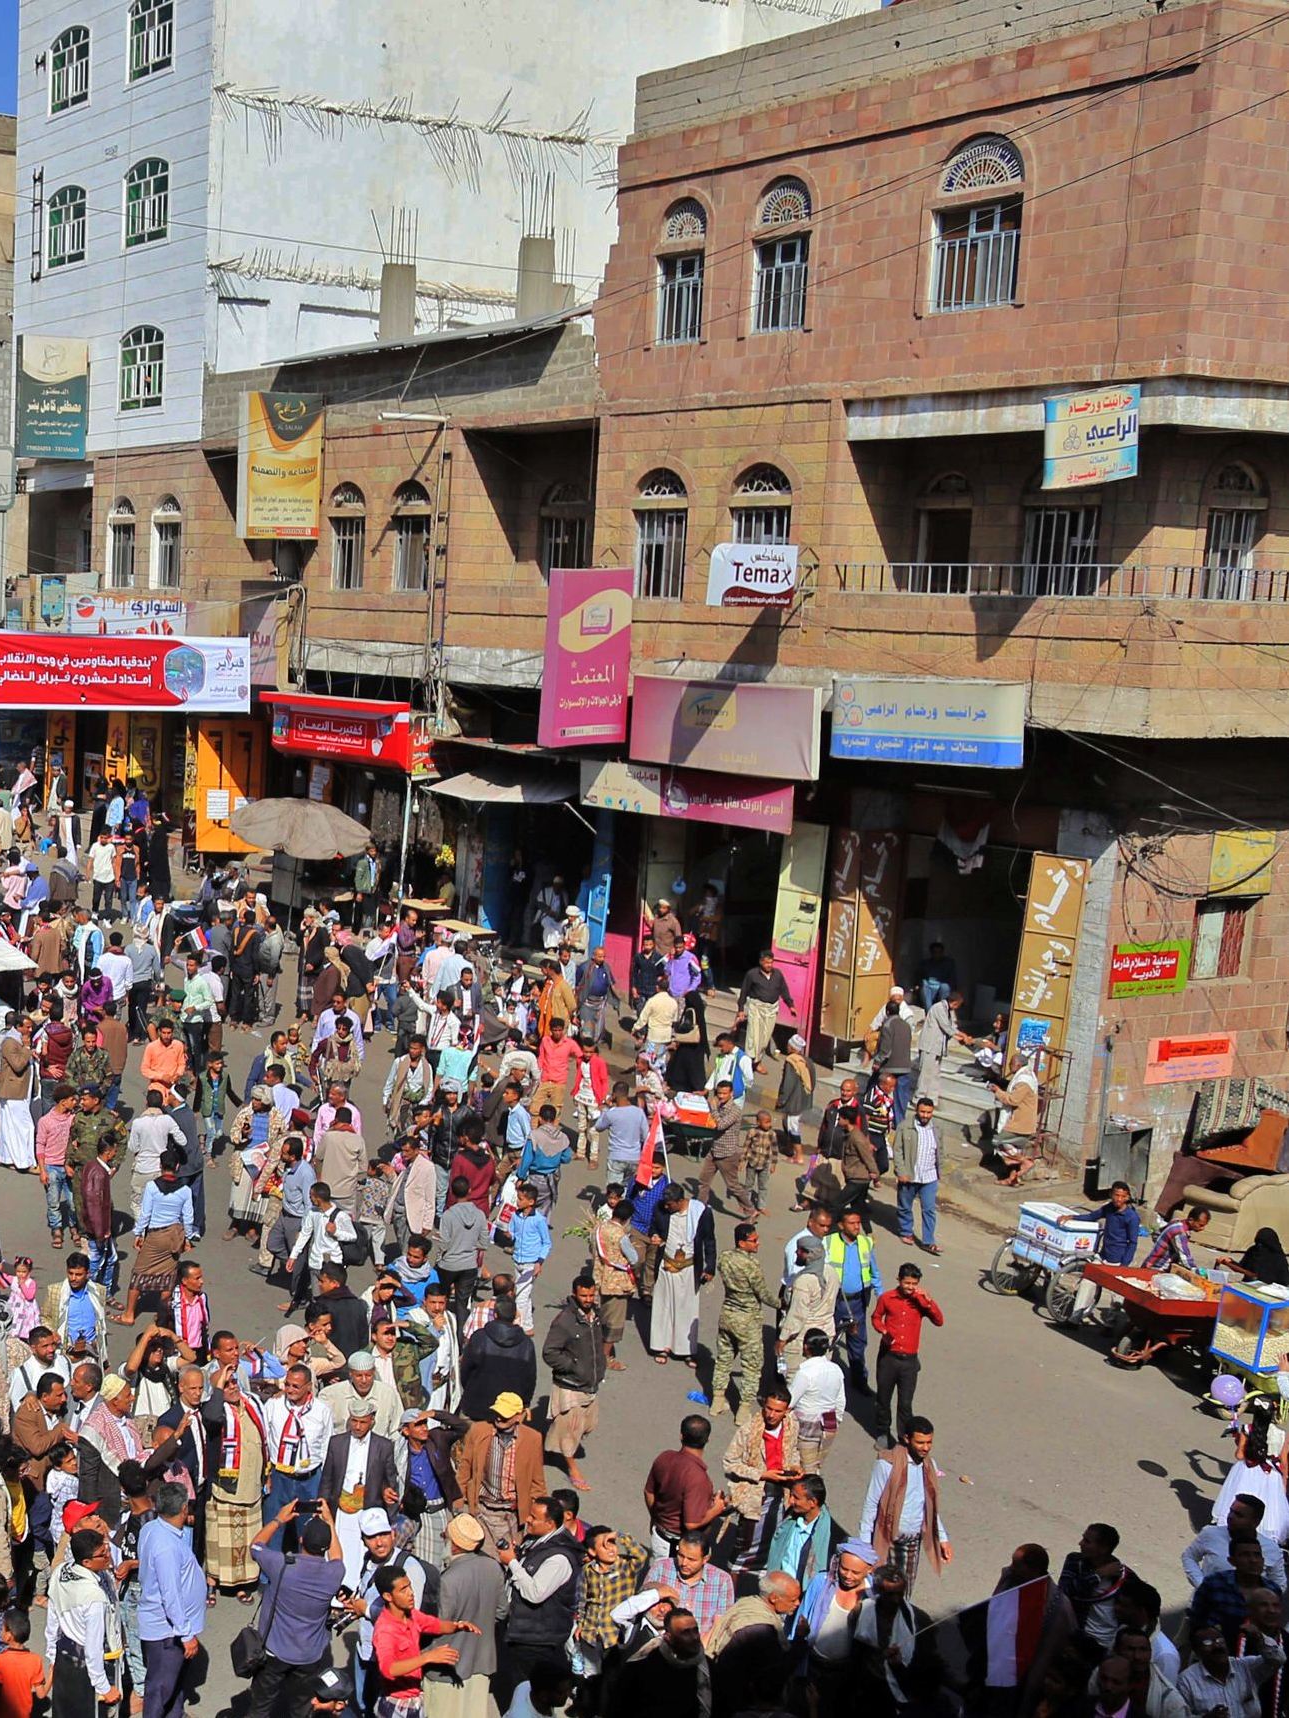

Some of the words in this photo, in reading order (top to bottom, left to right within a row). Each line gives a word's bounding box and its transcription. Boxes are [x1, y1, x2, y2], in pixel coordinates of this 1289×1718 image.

[1086, 414, 1137, 447] الراعبي
[733, 562, 792, 586] Temax
[131, 600, 183, 616] السواري
[37, 656, 56, 668] وجه
[57, 656, 70, 667] في
[71, 655, 120, 669] المقاومين
[36, 671, 71, 685] فبراير
[73, 672, 117, 686] لمشروع
[571, 664, 615, 684] المعتمد
[865, 703, 898, 720] الراعبي
[945, 706, 988, 721] جرانيت
[298, 719, 330, 734] النعمان
[331, 721, 363, 736] كفتيريا
[835, 831, 860, 895] رخام
[863, 832, 899, 898] رخام
[1032, 860, 1084, 931] رخام
[1130, 957, 1151, 973] السلام
[1152, 955, 1177, 968] صيدلية
